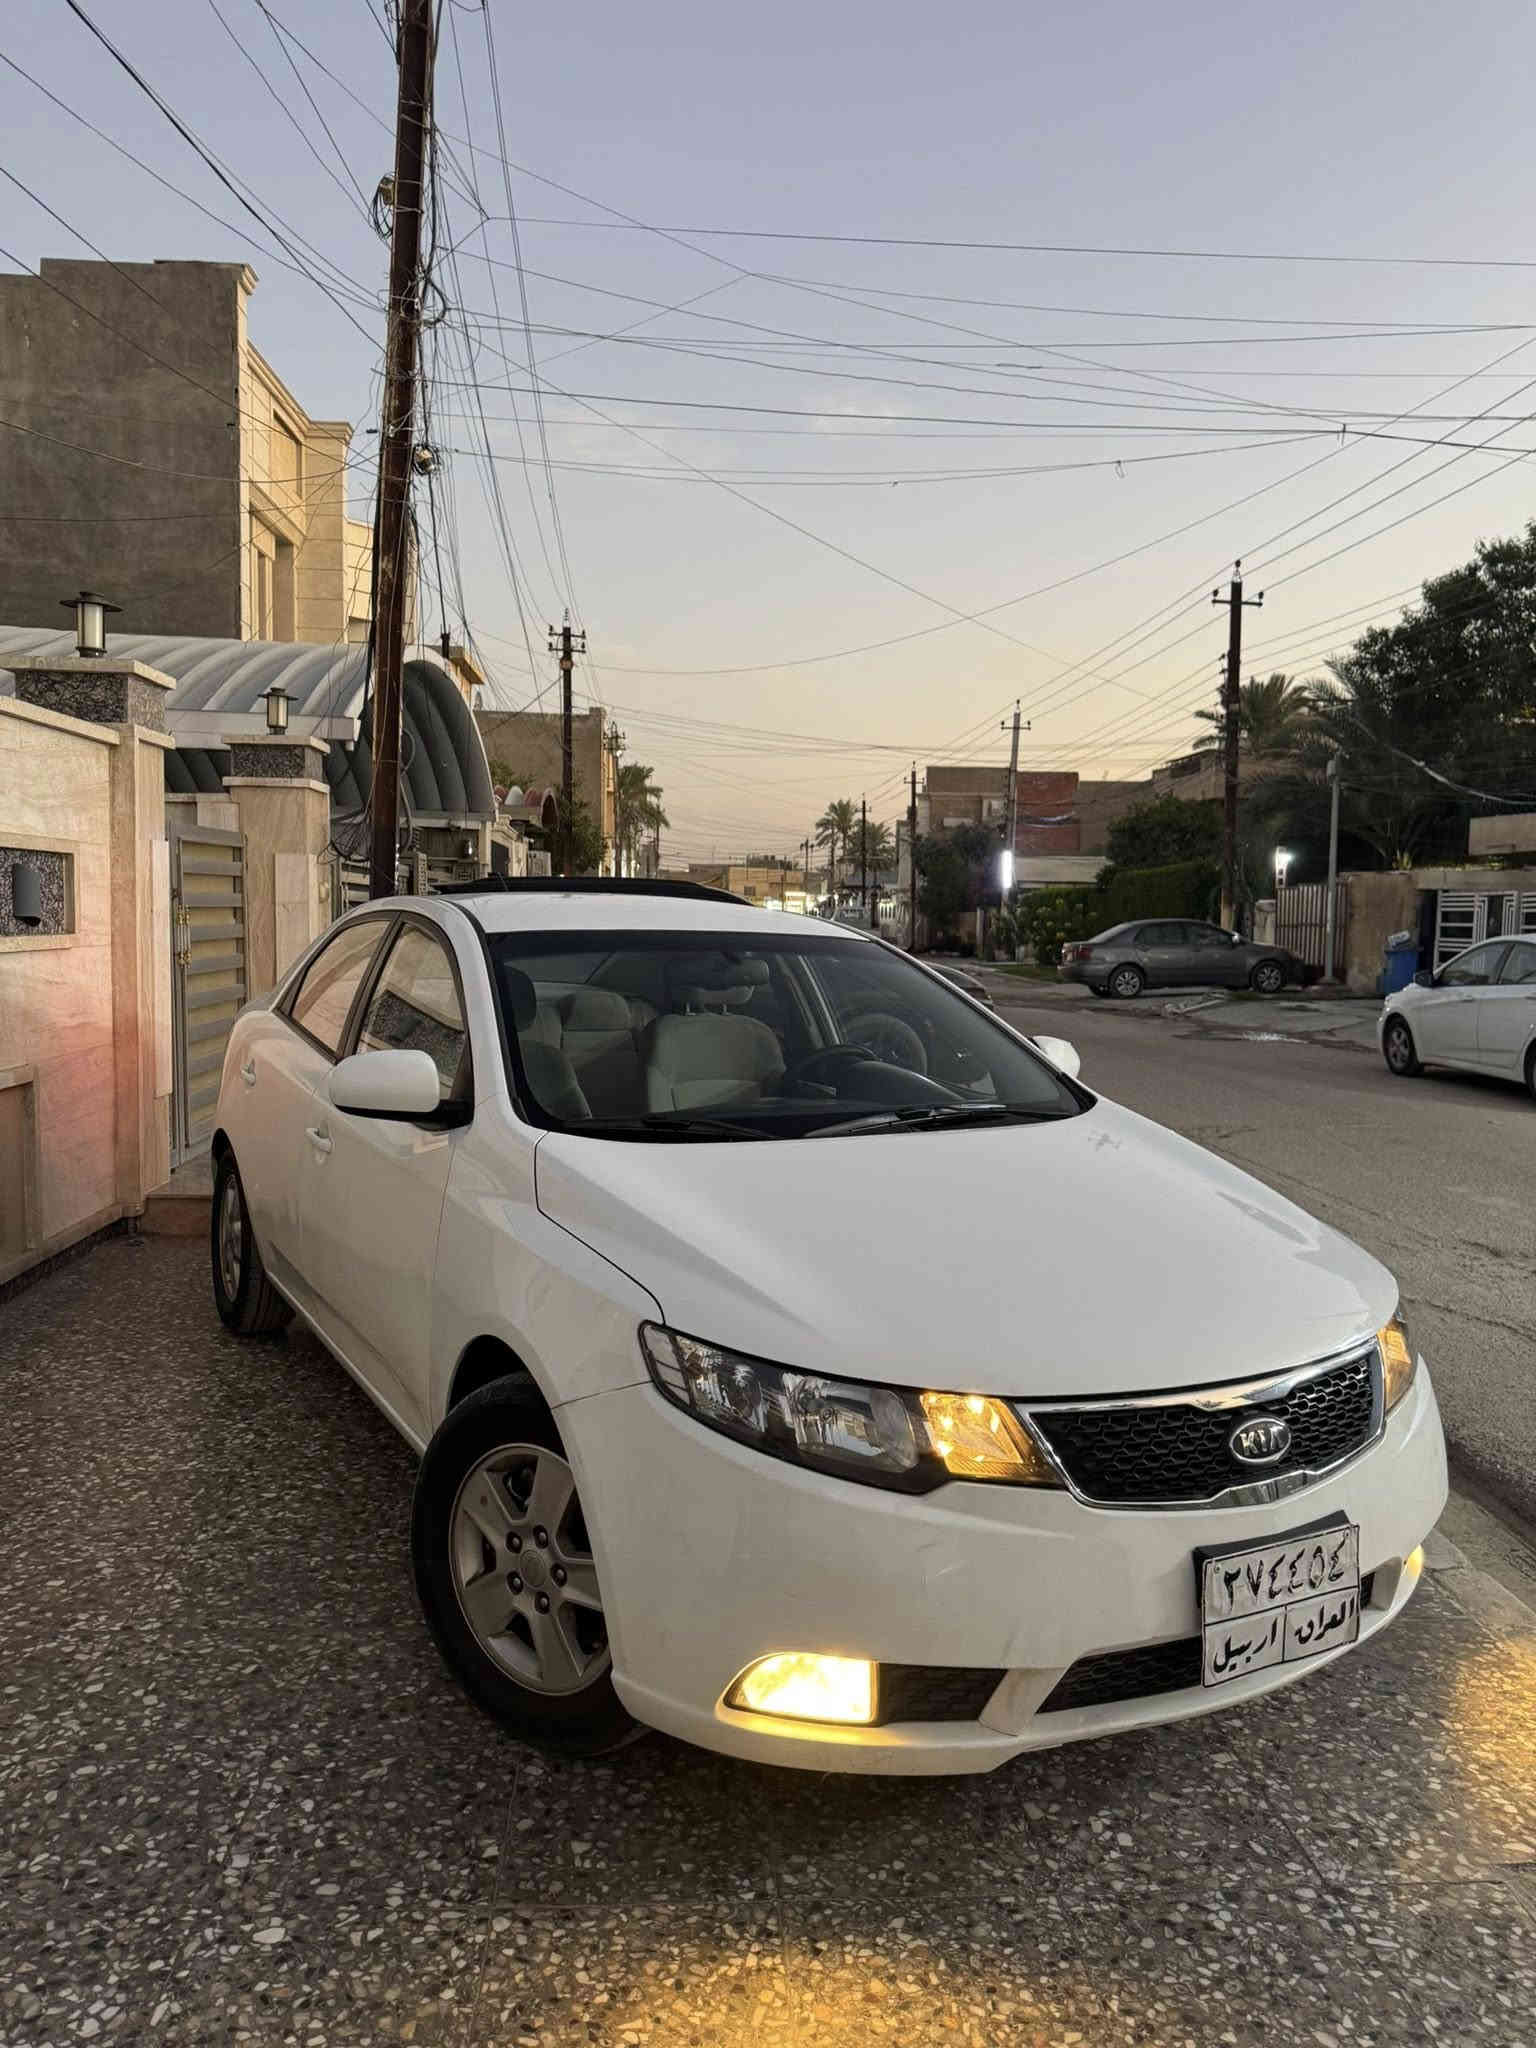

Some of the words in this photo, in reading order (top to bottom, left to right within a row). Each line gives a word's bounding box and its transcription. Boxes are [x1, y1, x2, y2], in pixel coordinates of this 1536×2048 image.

[1238, 1425, 1285, 1456] KIA
[1294, 1597, 1355, 1645] العراق
[1213, 1617, 1278, 1674] اربيل
